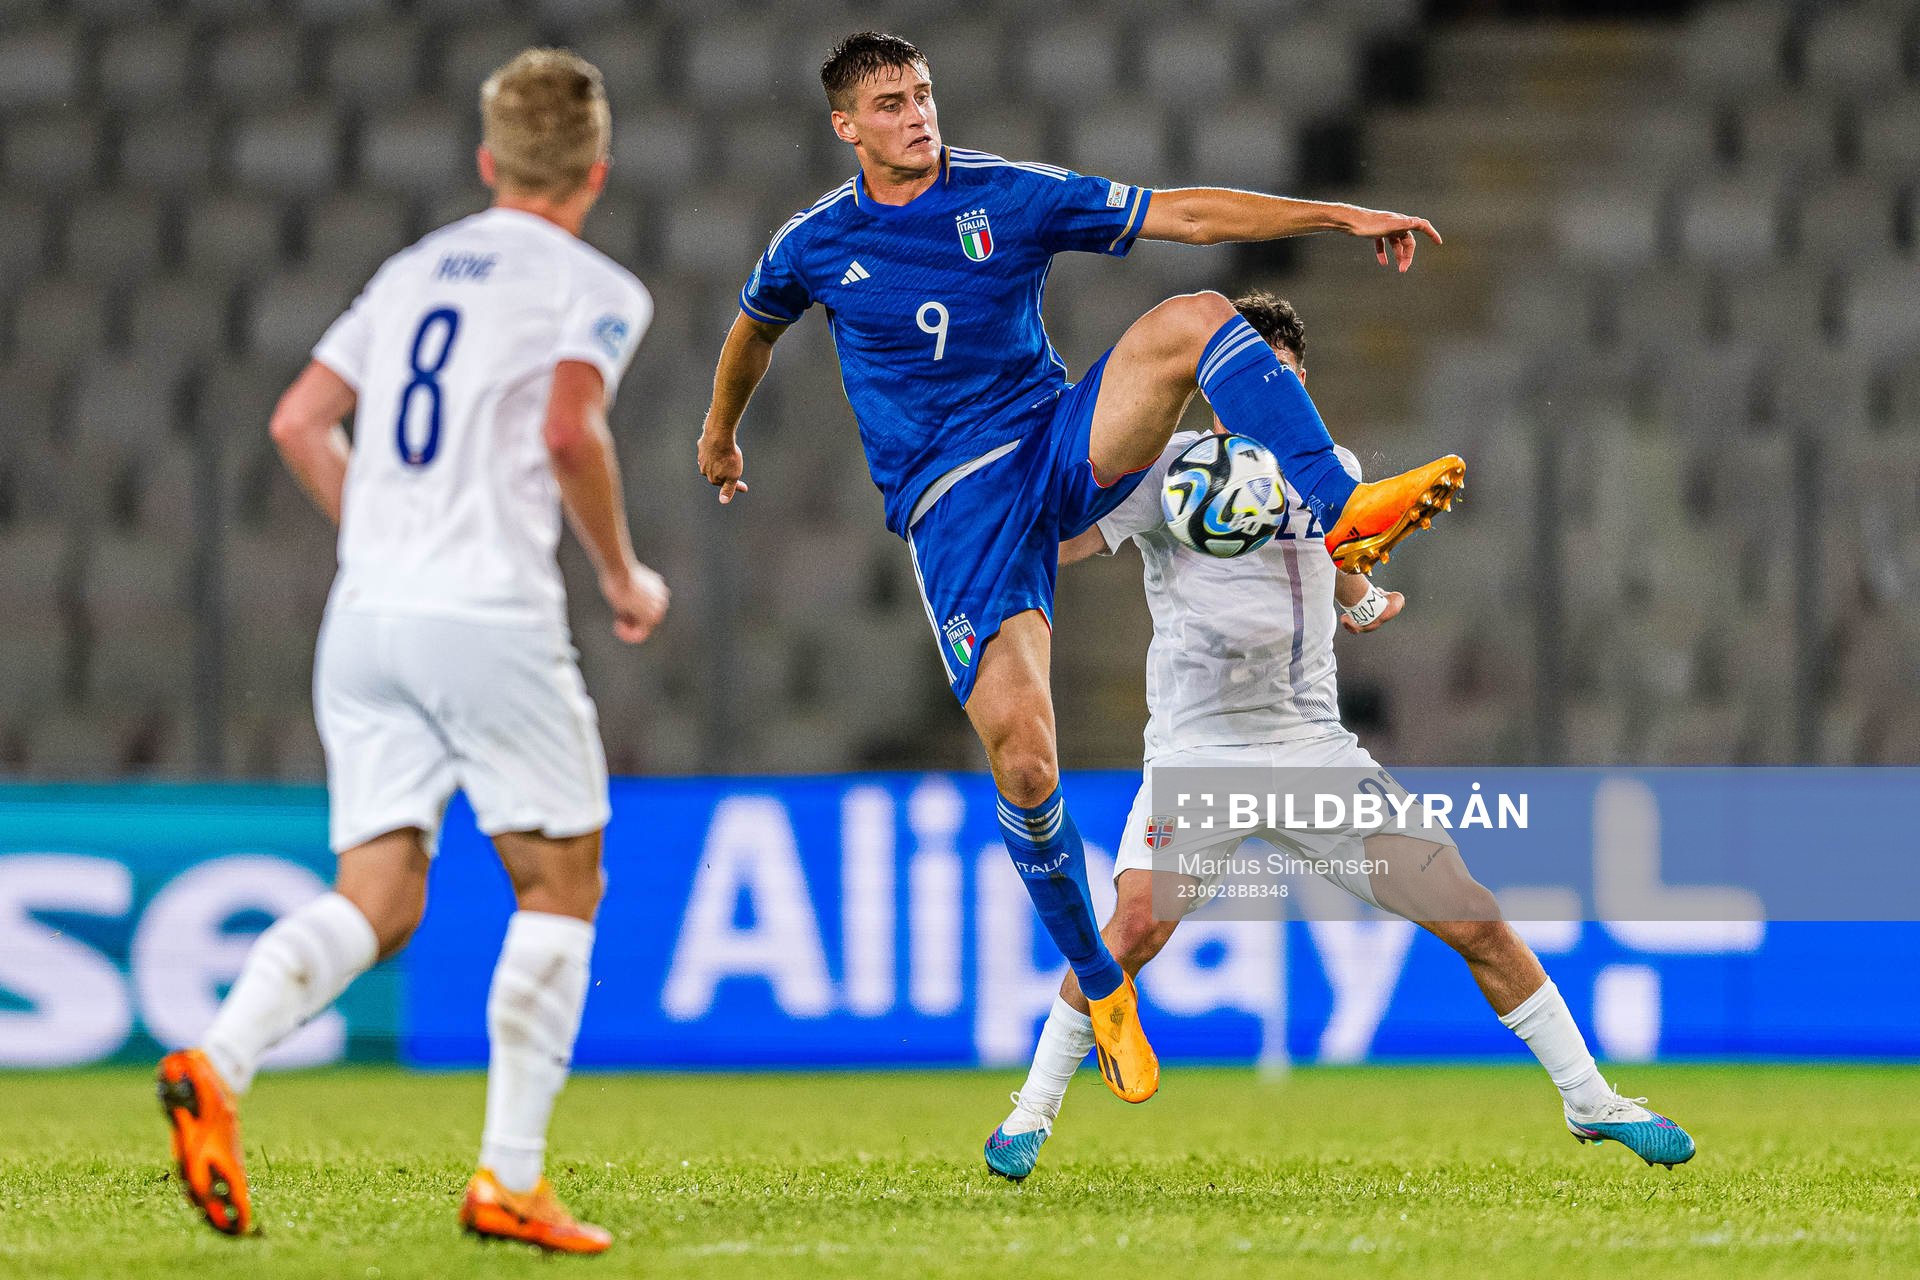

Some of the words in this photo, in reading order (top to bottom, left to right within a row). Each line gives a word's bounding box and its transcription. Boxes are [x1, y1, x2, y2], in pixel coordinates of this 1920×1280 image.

[959, 218, 987, 232] ITALIA
[915, 301, 949, 361] 9
[397, 303, 462, 467] 8
[949, 623, 971, 642] ITALIA
[1015, 852, 1069, 873] ITALIA
